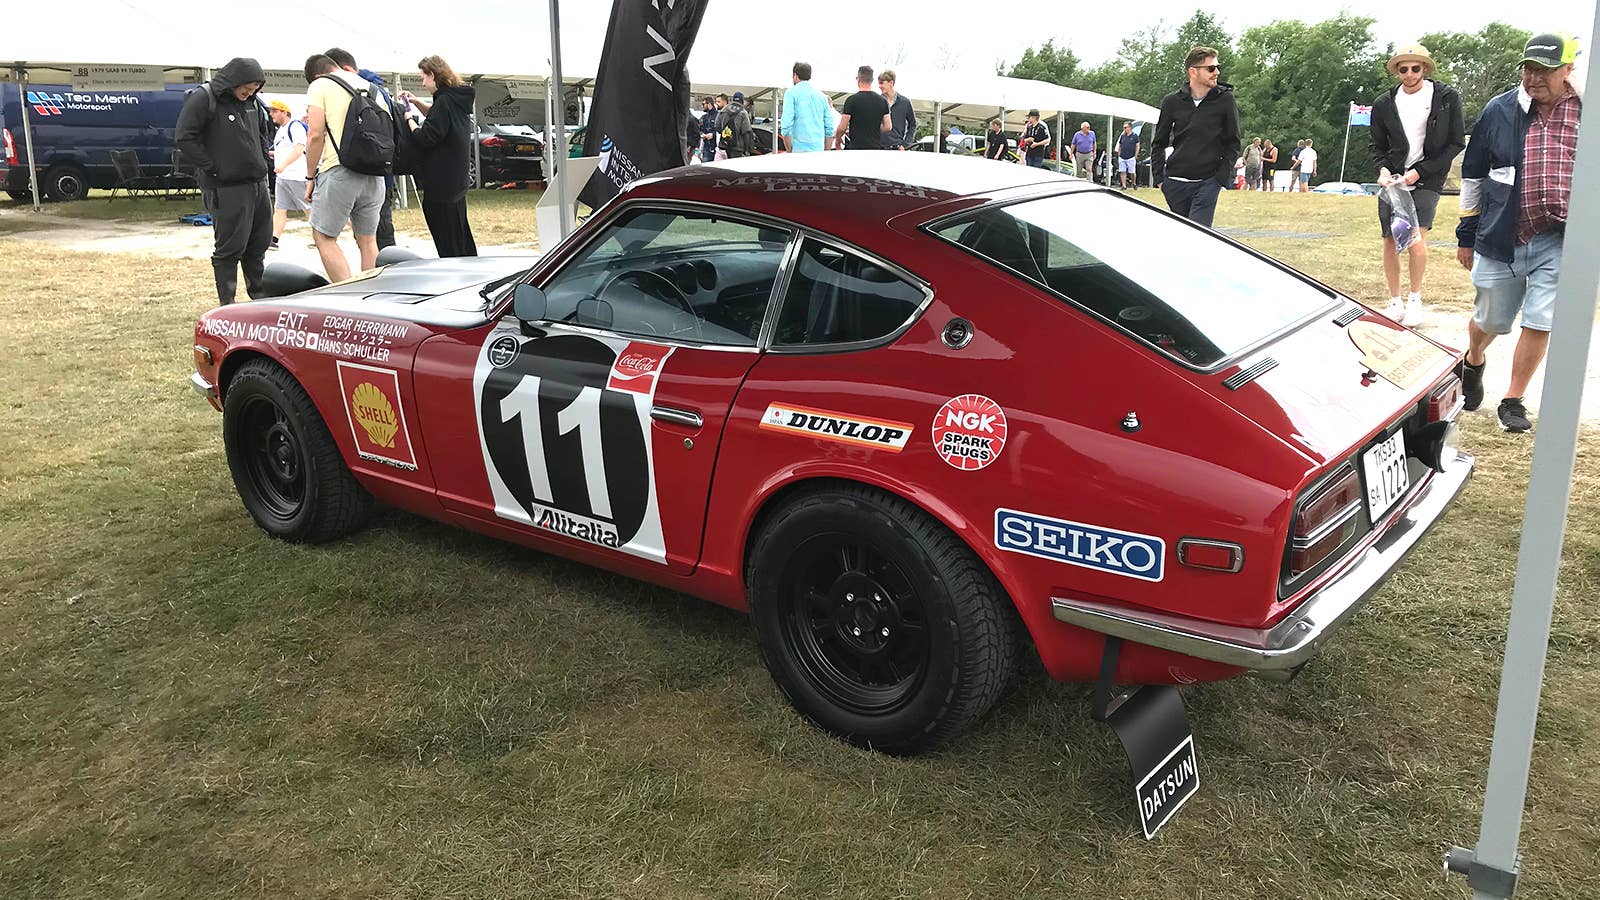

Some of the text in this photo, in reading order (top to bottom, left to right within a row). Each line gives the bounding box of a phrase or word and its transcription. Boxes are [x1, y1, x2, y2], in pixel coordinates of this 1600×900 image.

[64, 93, 92, 103] Teo
[66, 103, 112, 111] Motorsport
[610, 157, 633, 182] INTE
[712, 176, 829, 188] Mitsui
[763, 182, 939, 200] Lines Ltd.
[204, 318, 306, 348] NISSAN MOTORS
[277, 311, 309, 331] ENT.
[323, 315, 409, 339] EDGAR HERRMANN
[318, 338, 390, 362] HANS SCHULLER
[358, 405, 393, 426] SHELL
[945, 409, 997, 434] NGK
[786, 412, 904, 444] DUNLOP
[499, 373, 614, 520] 11
[943, 444, 989, 460] PLUGS
[944, 432, 991, 449] SPARK
[1381, 453, 1407, 505] 1223
[536, 508, 620, 549] Alitalia
[1002, 516, 1156, 572] SEIKO
[1143, 755, 1194, 821] DATSUN
